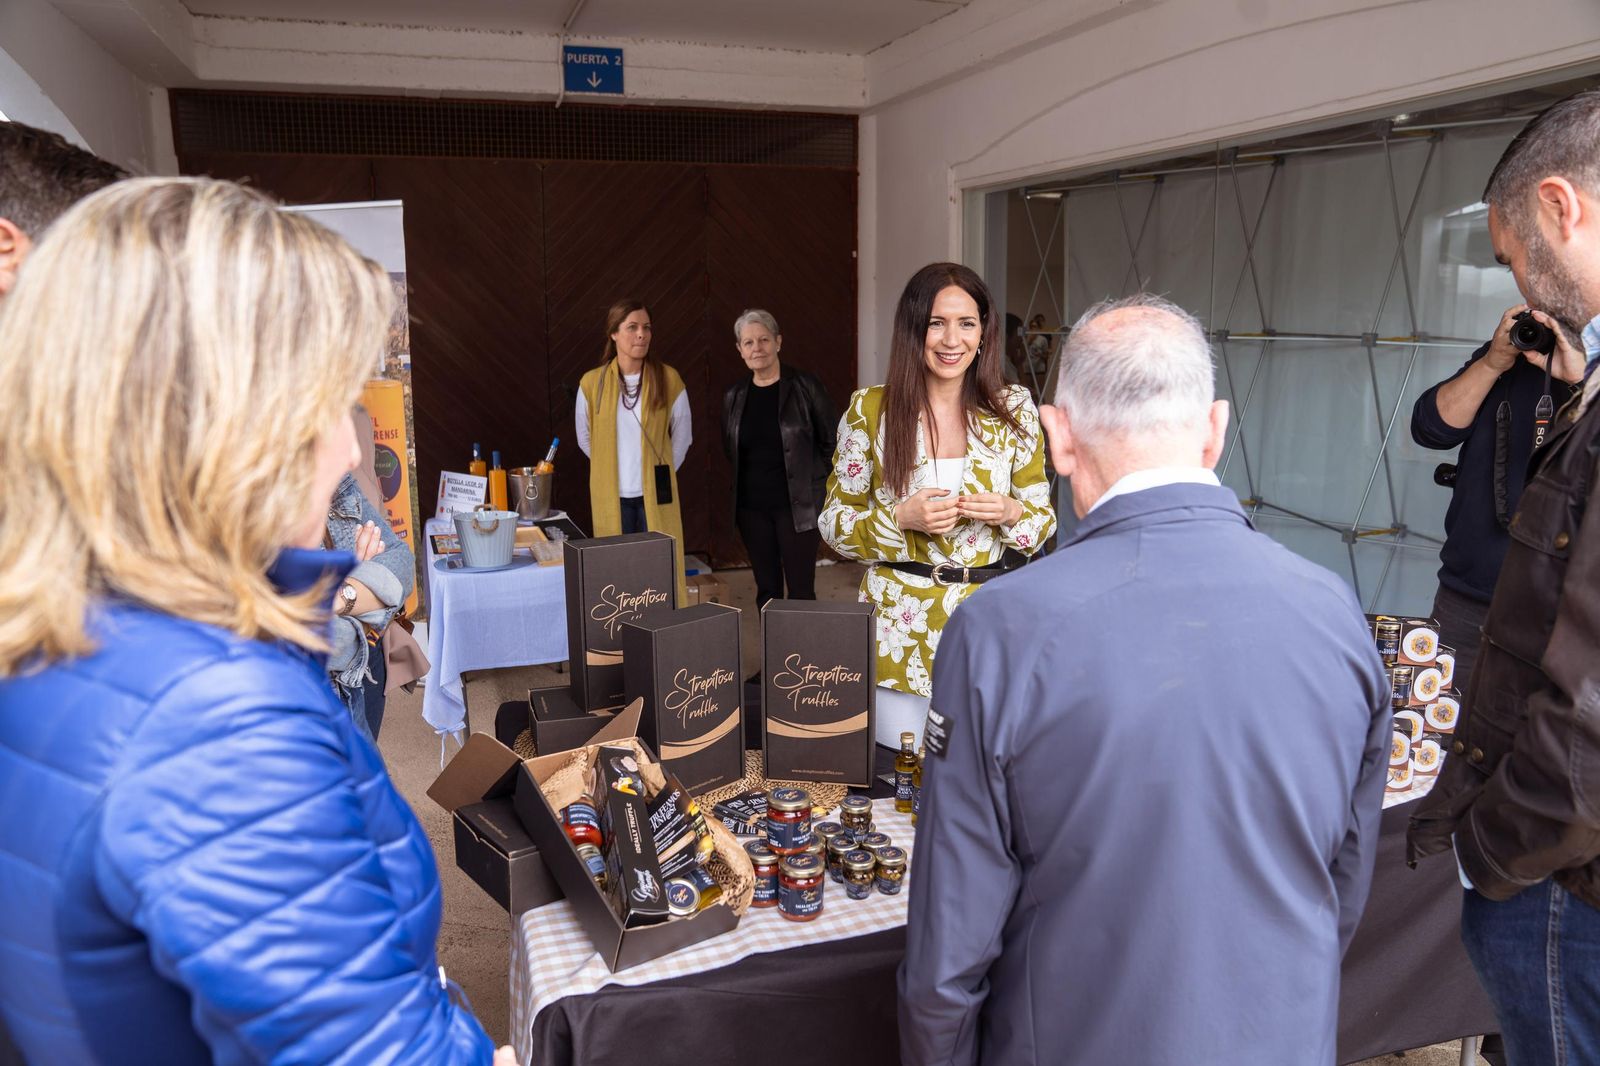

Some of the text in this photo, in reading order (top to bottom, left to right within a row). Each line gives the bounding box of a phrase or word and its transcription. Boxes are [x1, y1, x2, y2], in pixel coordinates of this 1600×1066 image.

[567, 53, 622, 66] PUERTA 2
[590, 584, 668, 621] Strepitosa
[664, 668, 735, 710] Strepitosa
[773, 653, 862, 689] Strepitosa
[676, 694, 719, 729] Truffles
[786, 684, 839, 712] Truffles
[626, 802, 642, 854] IDEALLY TRUFFLE
